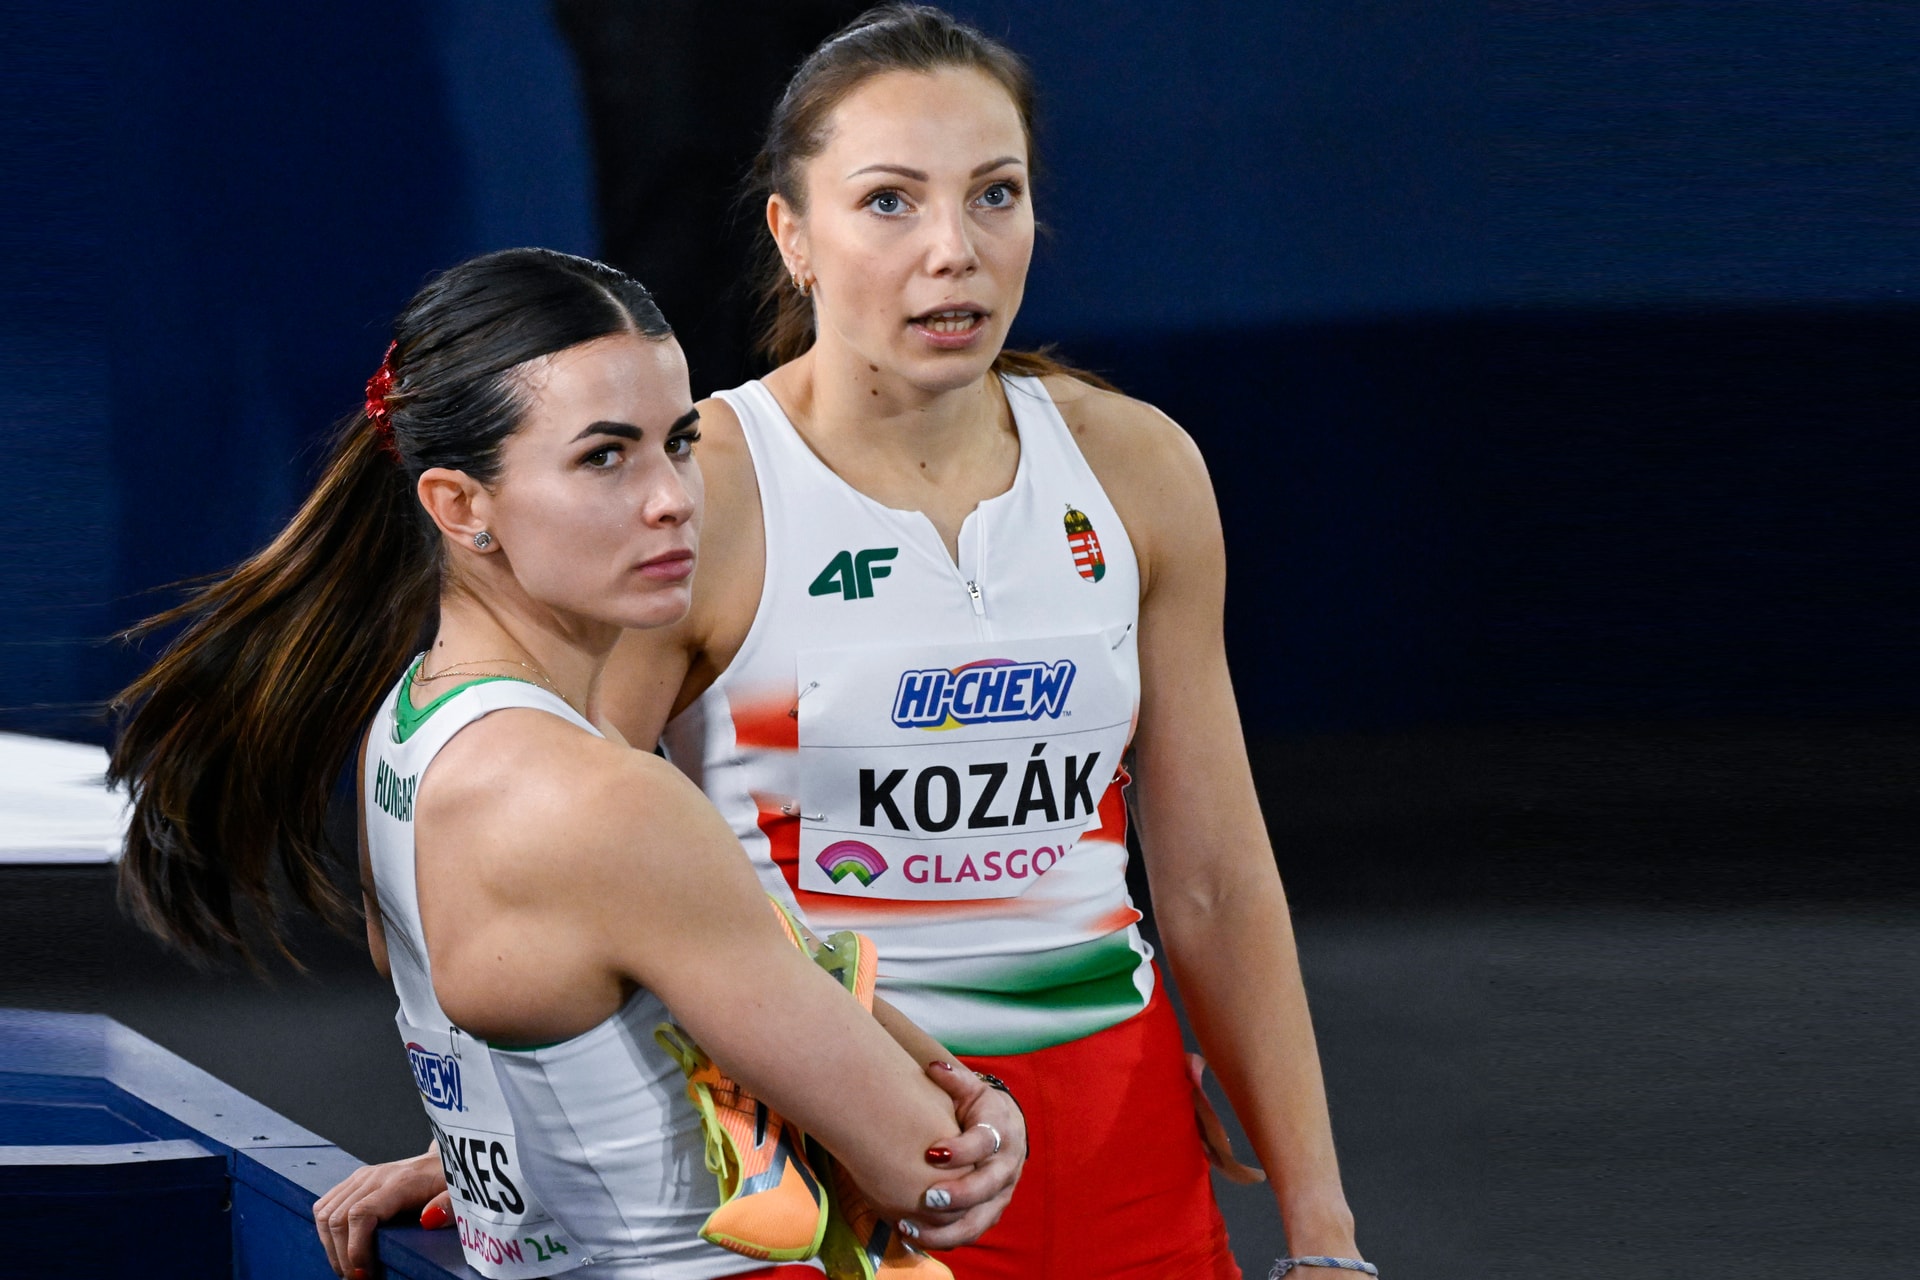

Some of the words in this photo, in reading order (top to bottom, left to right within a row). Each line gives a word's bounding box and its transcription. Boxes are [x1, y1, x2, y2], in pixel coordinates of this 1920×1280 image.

[808, 547, 899, 601] 4F
[891, 659, 1076, 728] HI-CHEW
[859, 742, 1102, 833] KOZÁK
[903, 844, 1073, 884] GLASGO
[457, 1215, 525, 1265] GLASGOW
[524, 1234, 569, 1262] 24
